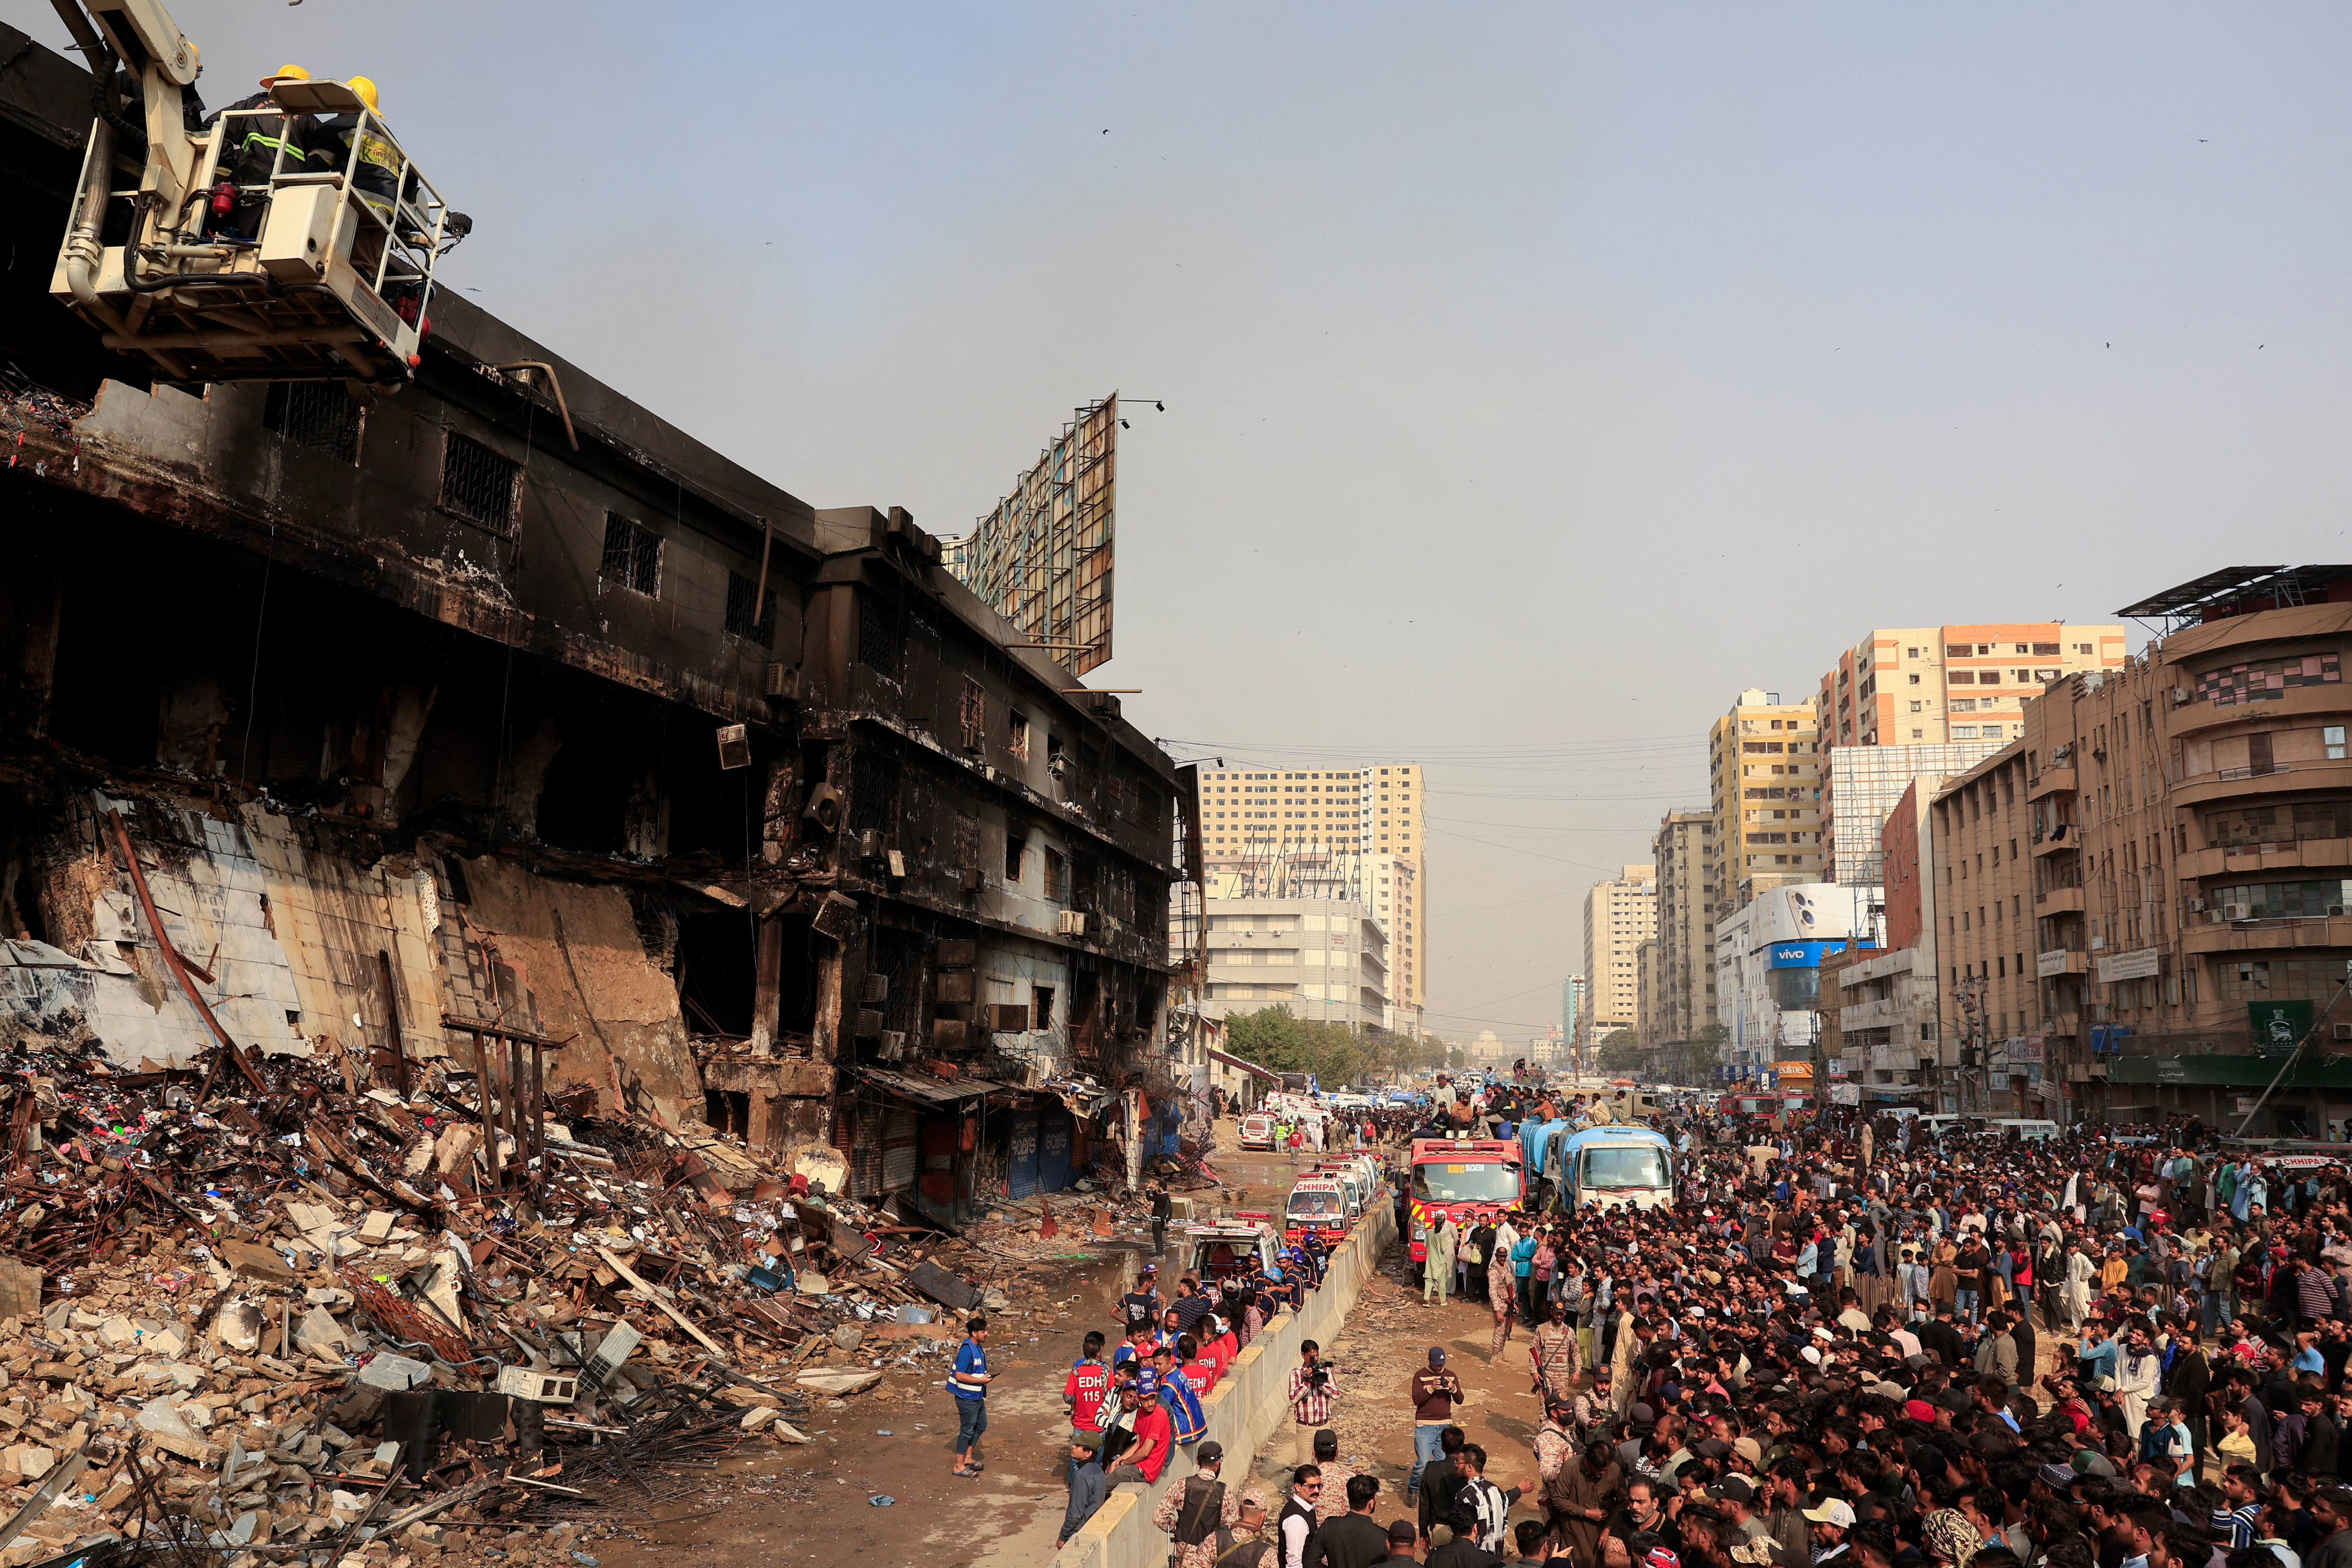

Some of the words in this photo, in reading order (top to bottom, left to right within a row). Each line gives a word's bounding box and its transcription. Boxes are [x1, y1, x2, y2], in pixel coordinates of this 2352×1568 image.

[1779, 949, 1804, 960] vivo
[1296, 1183, 1336, 1192] CHHIPA
[1078, 1376, 1102, 1388] EDH
[1083, 1391, 1100, 1402] 115
